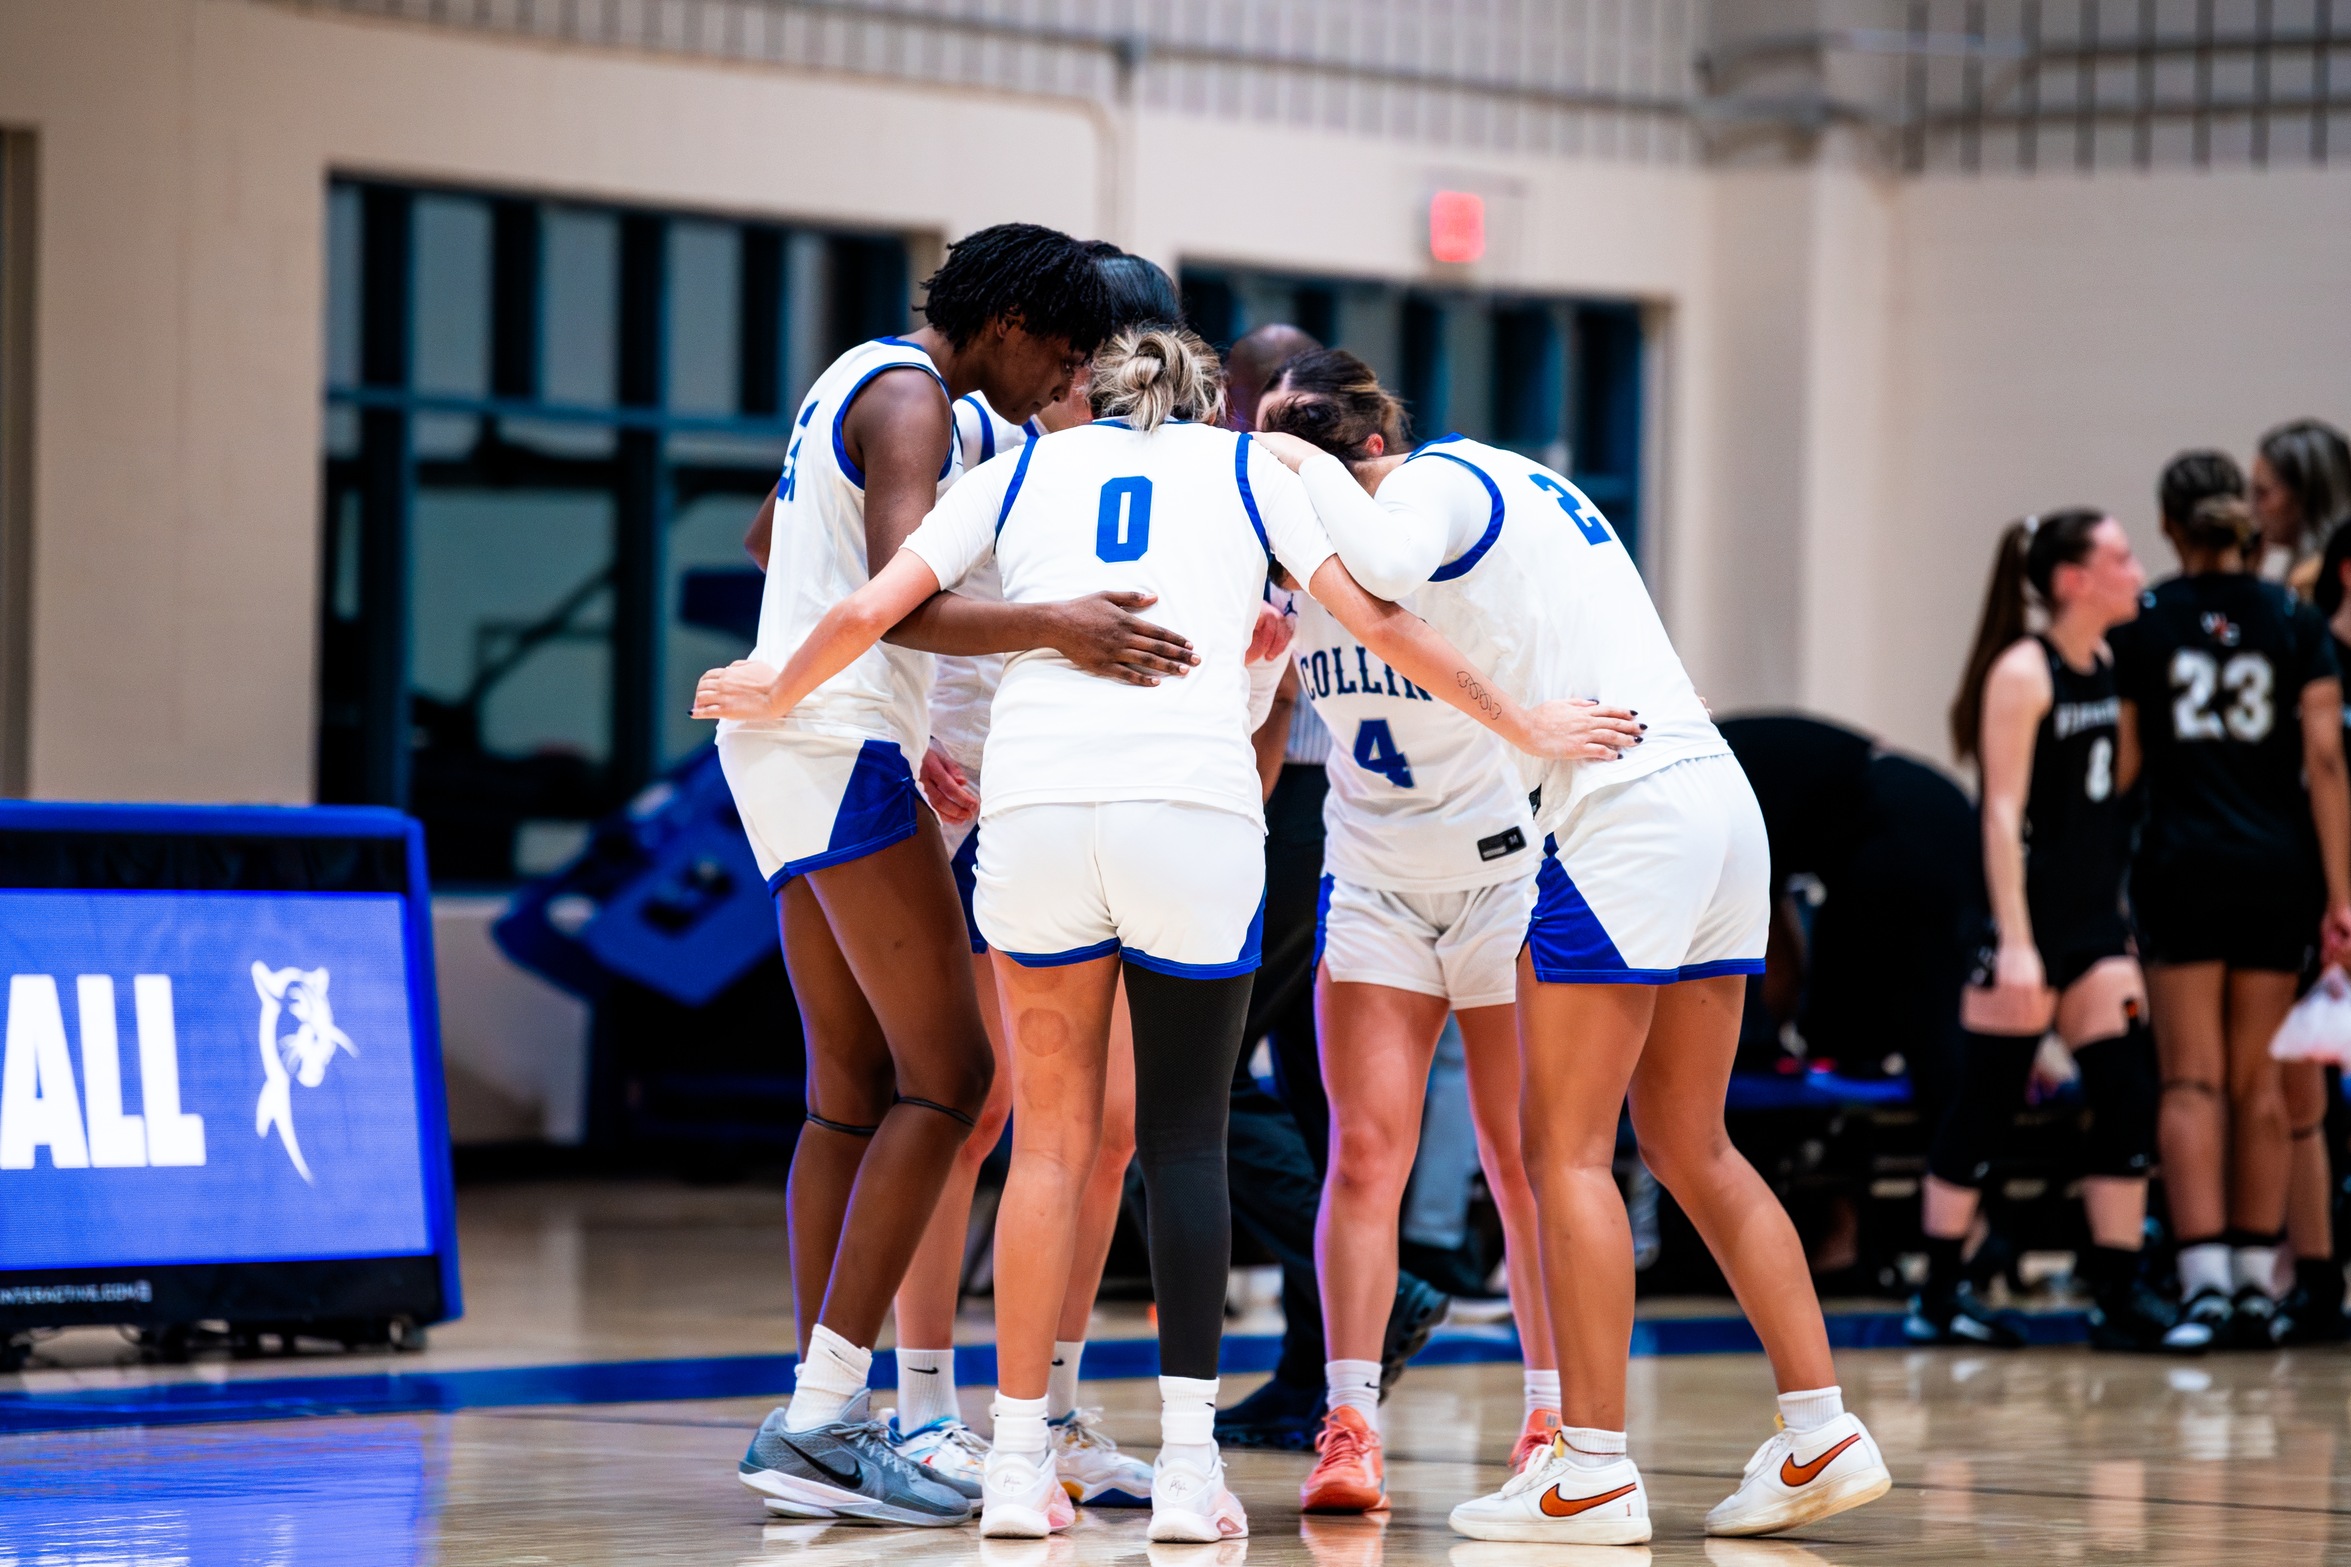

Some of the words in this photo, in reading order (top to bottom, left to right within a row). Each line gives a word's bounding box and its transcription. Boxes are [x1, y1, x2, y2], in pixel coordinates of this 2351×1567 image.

[1096, 475, 1152, 563] 0
[1528, 473, 1612, 546] 2
[2169, 647, 2275, 743] 23
[1352, 718, 1415, 789] 4
[0, 974, 206, 1169] ALL
